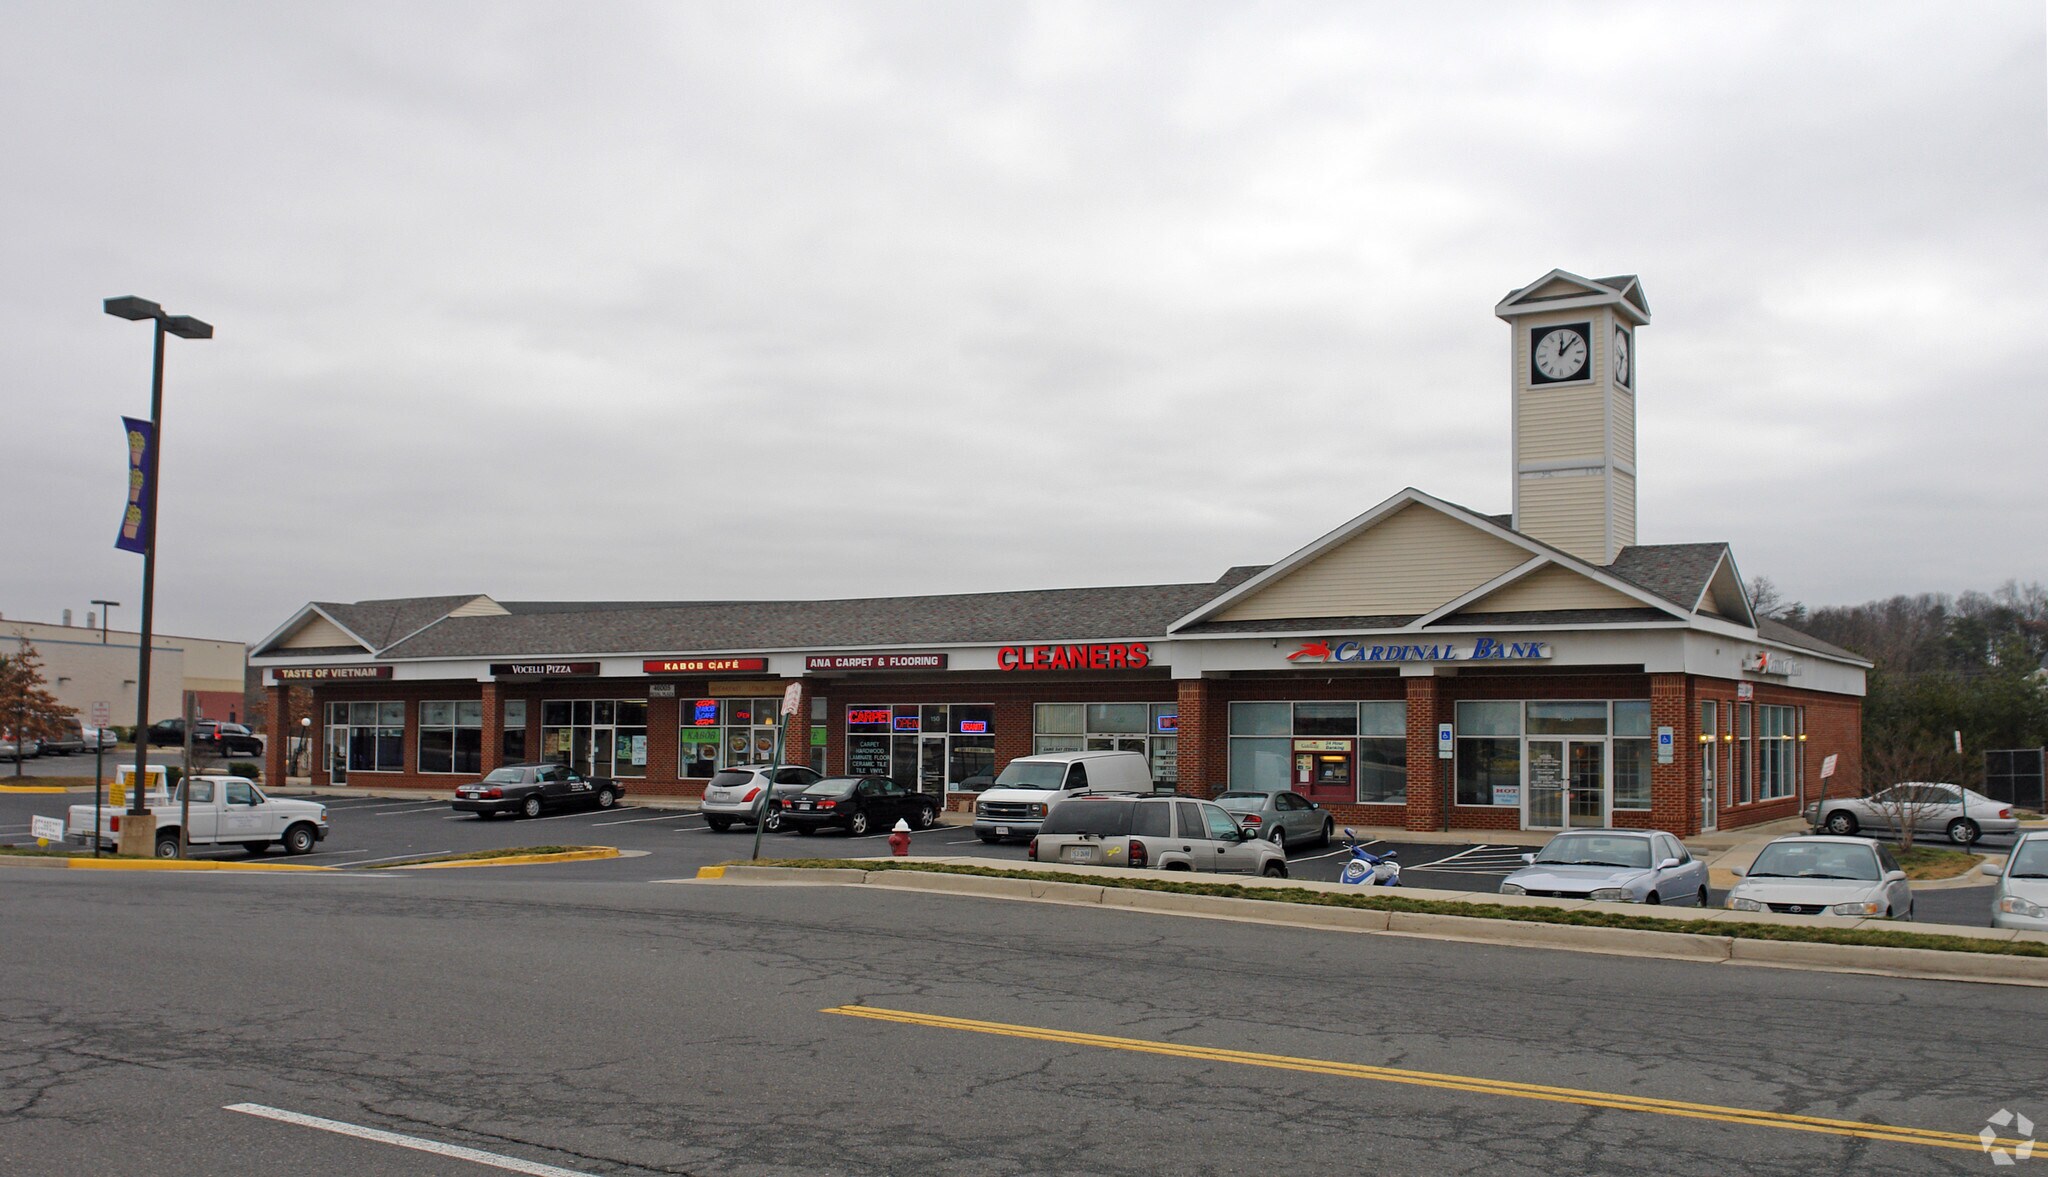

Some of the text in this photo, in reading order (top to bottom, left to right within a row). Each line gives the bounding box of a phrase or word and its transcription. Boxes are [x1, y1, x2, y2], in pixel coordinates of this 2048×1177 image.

[1334, 637, 1545, 661] CARDINAL BANK
[810, 656, 938, 667] ANA CARPET & FLOORING
[997, 643, 1150, 671] CLEANERS
[664, 659, 739, 670] KABOB CAFÉ
[282, 668, 377, 678] TASTE OF VIETNAM
[737, 711, 750, 719] OPEN
[849, 710, 891, 723] CARPET
[896, 718, 919, 729] OPEN
[687, 731, 716, 740] KABOB
